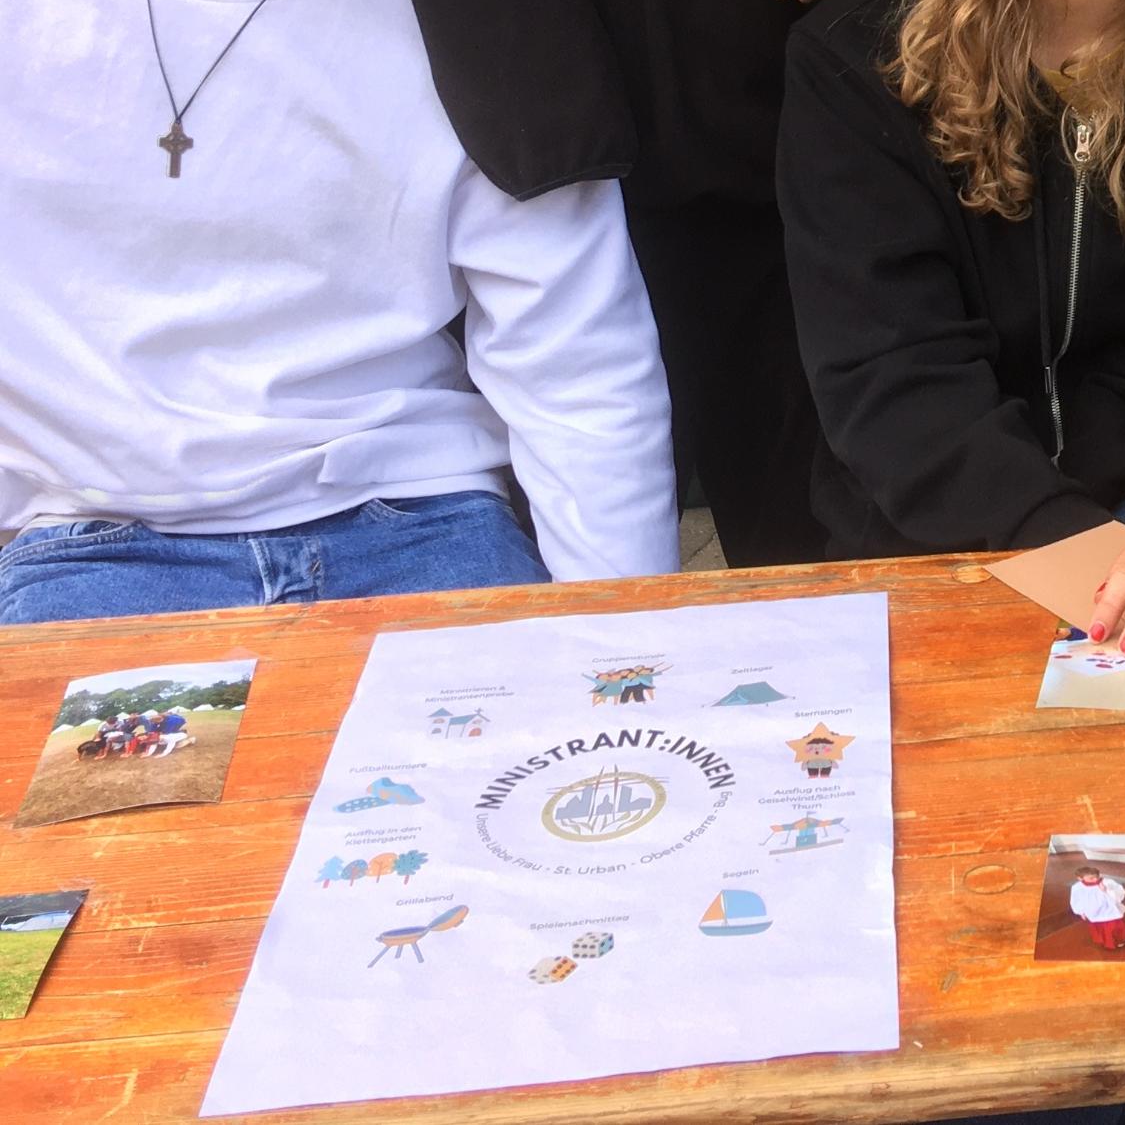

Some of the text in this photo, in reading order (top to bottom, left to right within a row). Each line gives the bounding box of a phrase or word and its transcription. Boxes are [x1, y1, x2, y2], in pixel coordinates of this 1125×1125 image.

[731, 665, 774, 675] Zeltlager
[795, 708, 853, 718] Sternsingen
[474, 729, 736, 810] MINISTRANT:INNEN
[774, 787, 813, 796] Ausflug
[345, 827, 385, 838] Ausflug
[514, 857, 542, 872] Frau
[577, 863, 627, 875] Urban
[640, 841, 685, 864] Obere
[686, 816, 717, 844] Pfarre
[722, 868, 760, 879] Segeln
[396, 893, 454, 907] Grillabend
